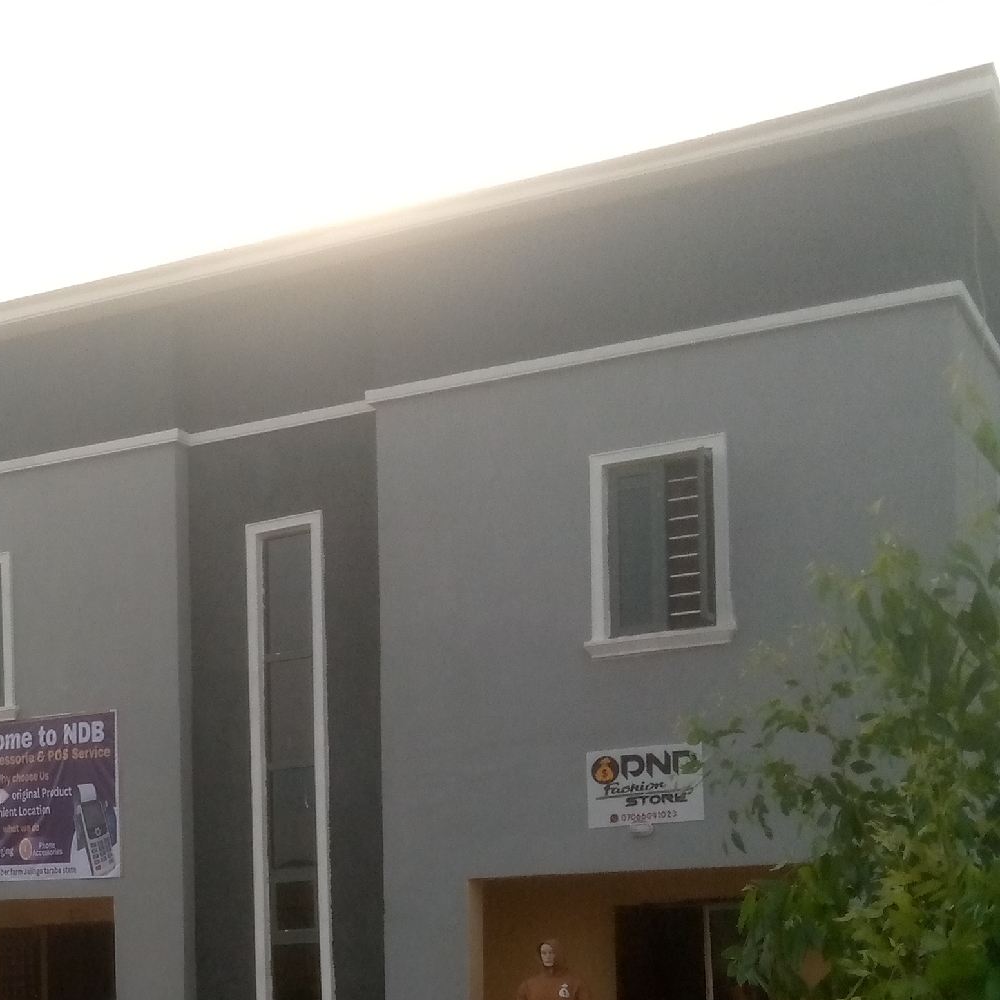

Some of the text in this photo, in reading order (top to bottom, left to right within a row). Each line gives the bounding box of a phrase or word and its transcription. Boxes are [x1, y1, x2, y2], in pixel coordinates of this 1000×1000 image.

[38, 726, 57, 747] to
[63, 720, 105, 744] NDB
[37, 750, 45, 762] &
[47, 747, 69, 761] POS
[72, 745, 110, 760] Service
[12, 772, 38, 783] choose
[39, 770, 49, 781] Us
[11, 785, 72, 803] original Product
[625, 793, 688, 807] STORE
[19, 804, 51, 817] Location
